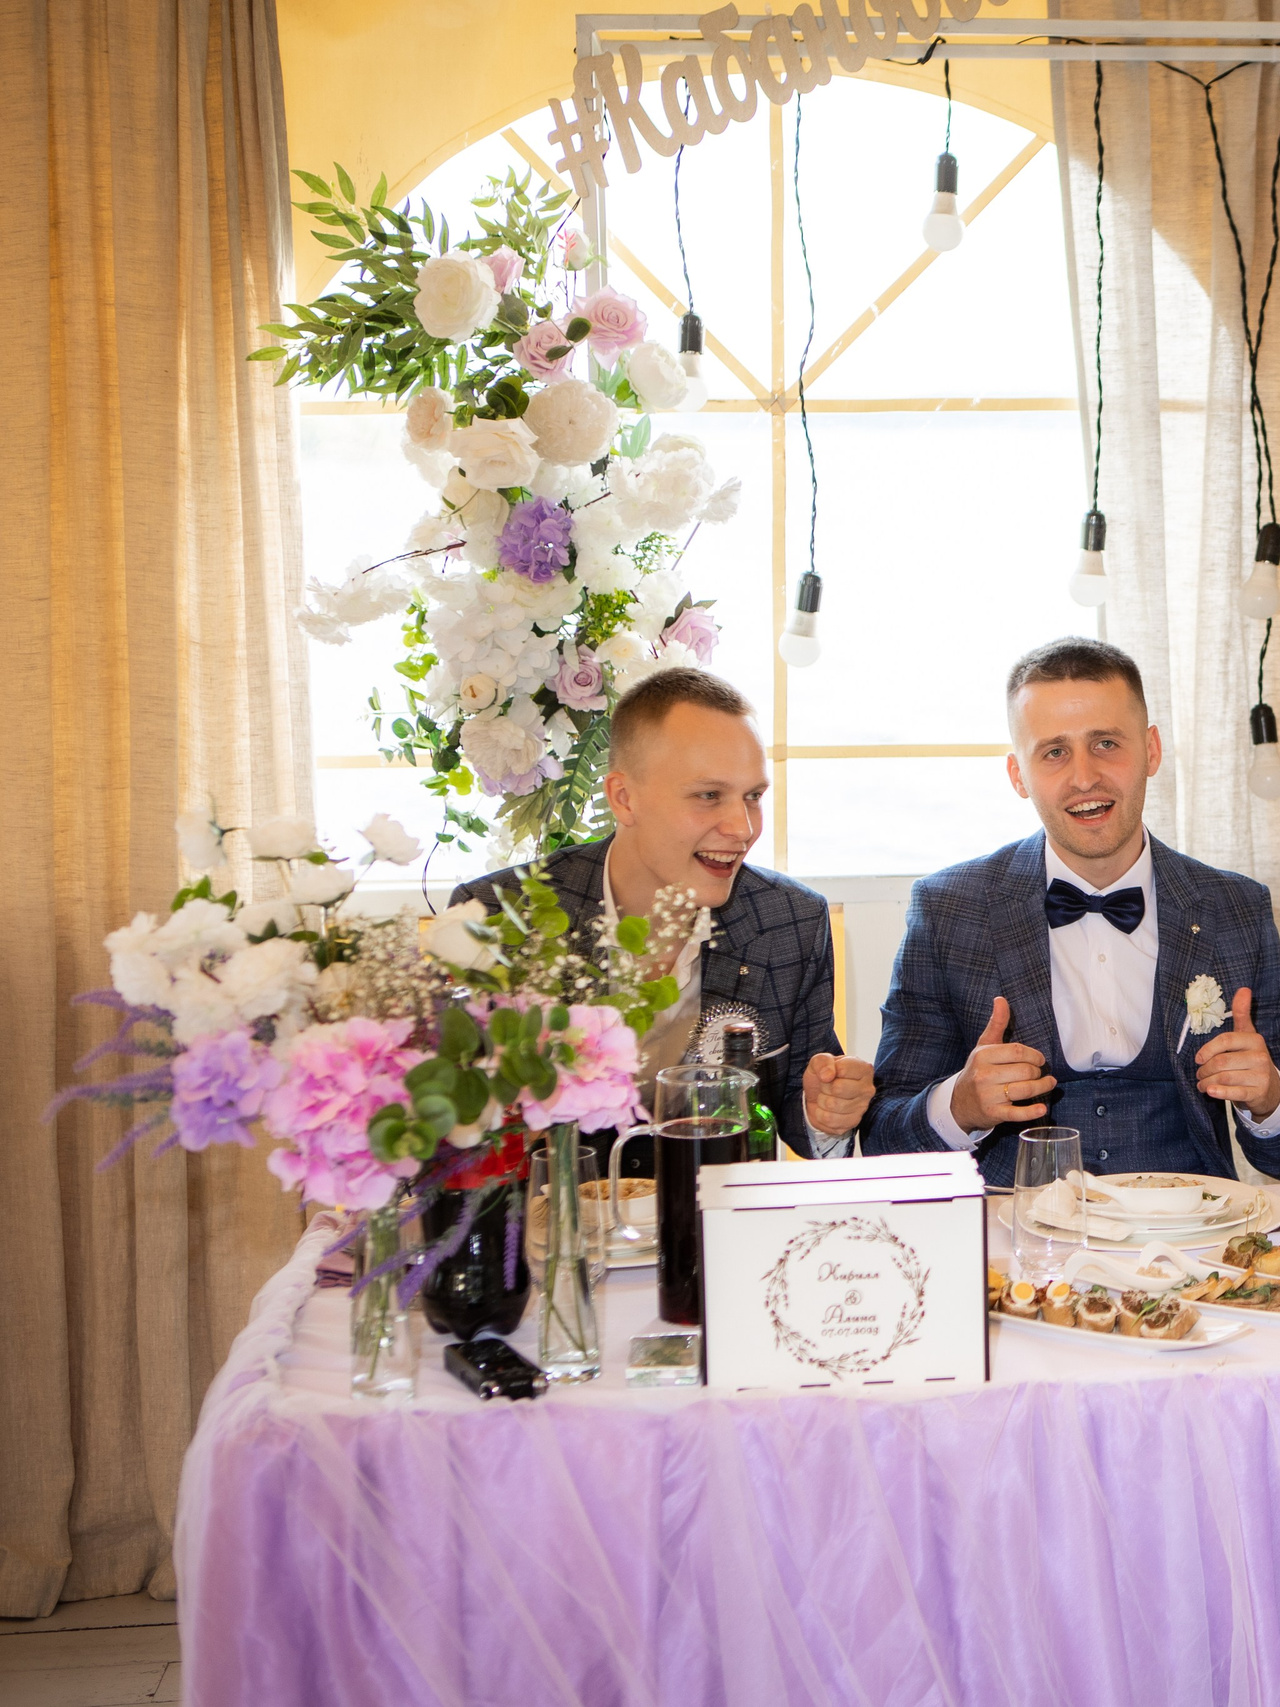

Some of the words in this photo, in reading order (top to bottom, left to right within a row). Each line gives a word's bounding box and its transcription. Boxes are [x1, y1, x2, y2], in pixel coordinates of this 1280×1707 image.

[817, 1262, 879, 1283] Кирилл
[844, 1289, 862, 1305] &
[822, 1304, 876, 1324] Алина
[821, 1326, 879, 1338] 07.07.2023
